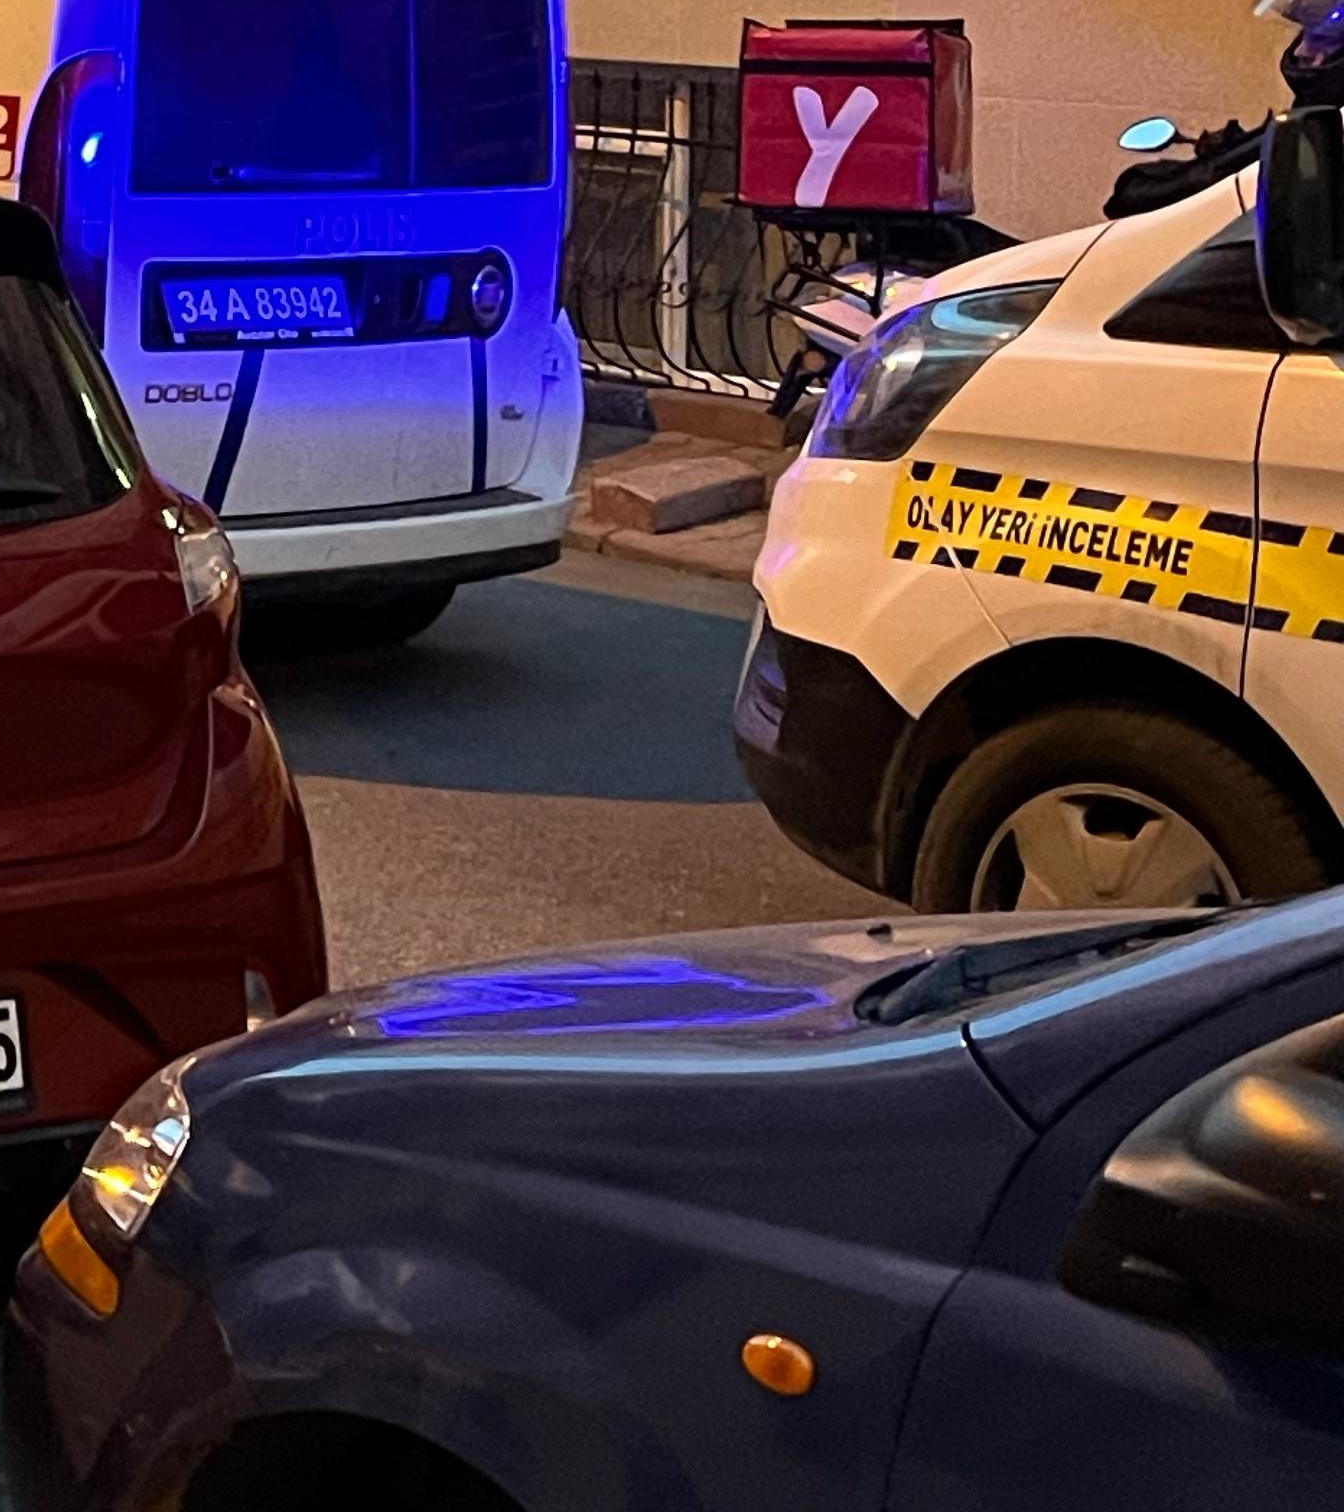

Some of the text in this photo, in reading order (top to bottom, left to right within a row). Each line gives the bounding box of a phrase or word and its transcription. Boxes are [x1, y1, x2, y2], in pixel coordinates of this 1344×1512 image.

[793, 86, 879, 207] Y
[178, 287, 342, 324] 34 A 83942
[144, 382, 232, 403] DOBLO
[907, 495, 975, 535] OLAY
